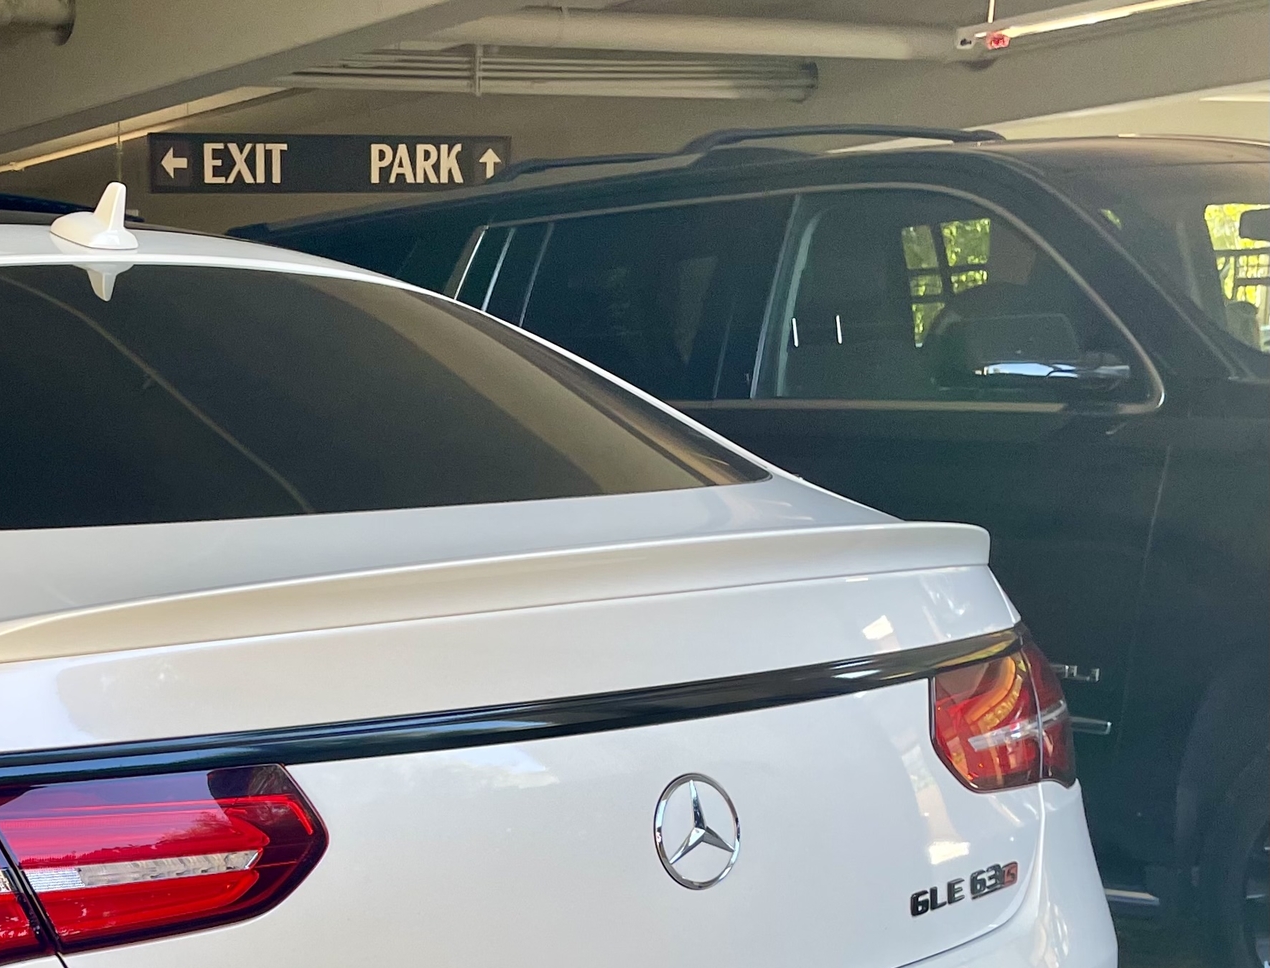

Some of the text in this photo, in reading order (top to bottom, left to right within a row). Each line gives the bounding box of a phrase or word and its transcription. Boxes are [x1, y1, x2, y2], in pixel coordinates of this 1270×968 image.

[203, 142, 465, 184] EXIT PARK
[910, 878, 966, 917] GLE
